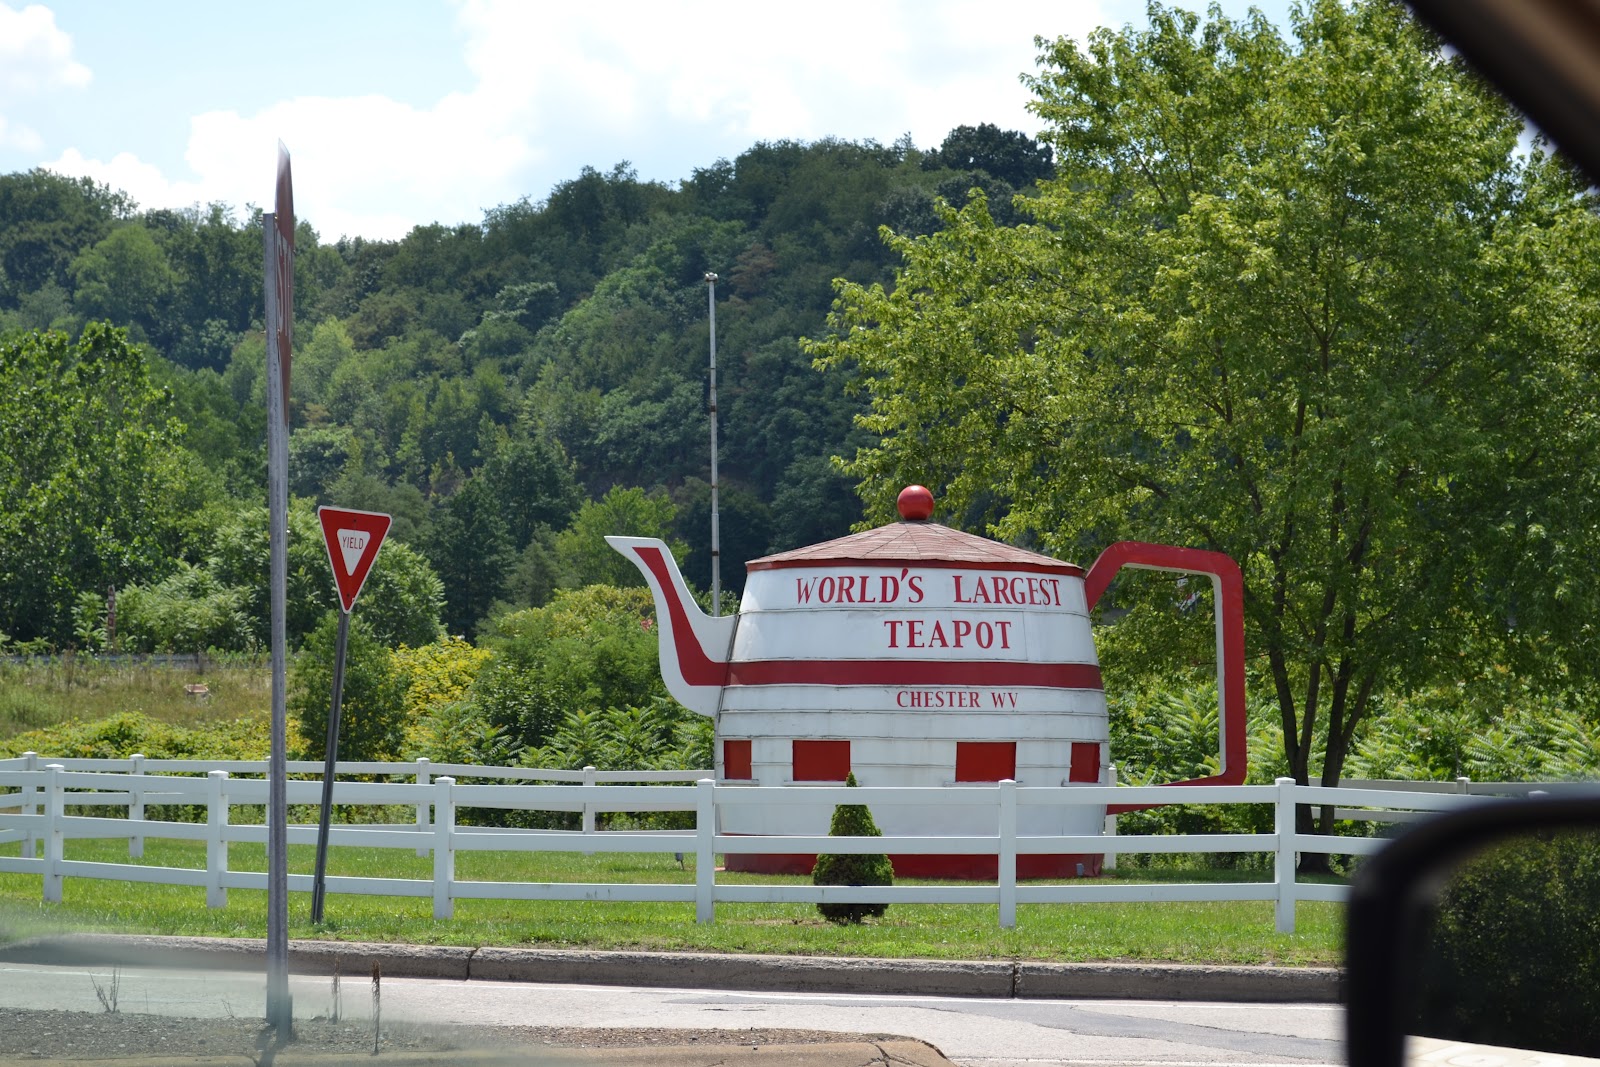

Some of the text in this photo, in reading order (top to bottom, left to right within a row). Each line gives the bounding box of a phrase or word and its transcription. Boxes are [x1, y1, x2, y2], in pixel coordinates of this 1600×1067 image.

[342, 536, 364, 550] YIELD
[796, 568, 1062, 607] WORLD'S LARGEST
[883, 620, 1012, 649] TEAPOT
[896, 691, 1019, 709] CHESTER WV
